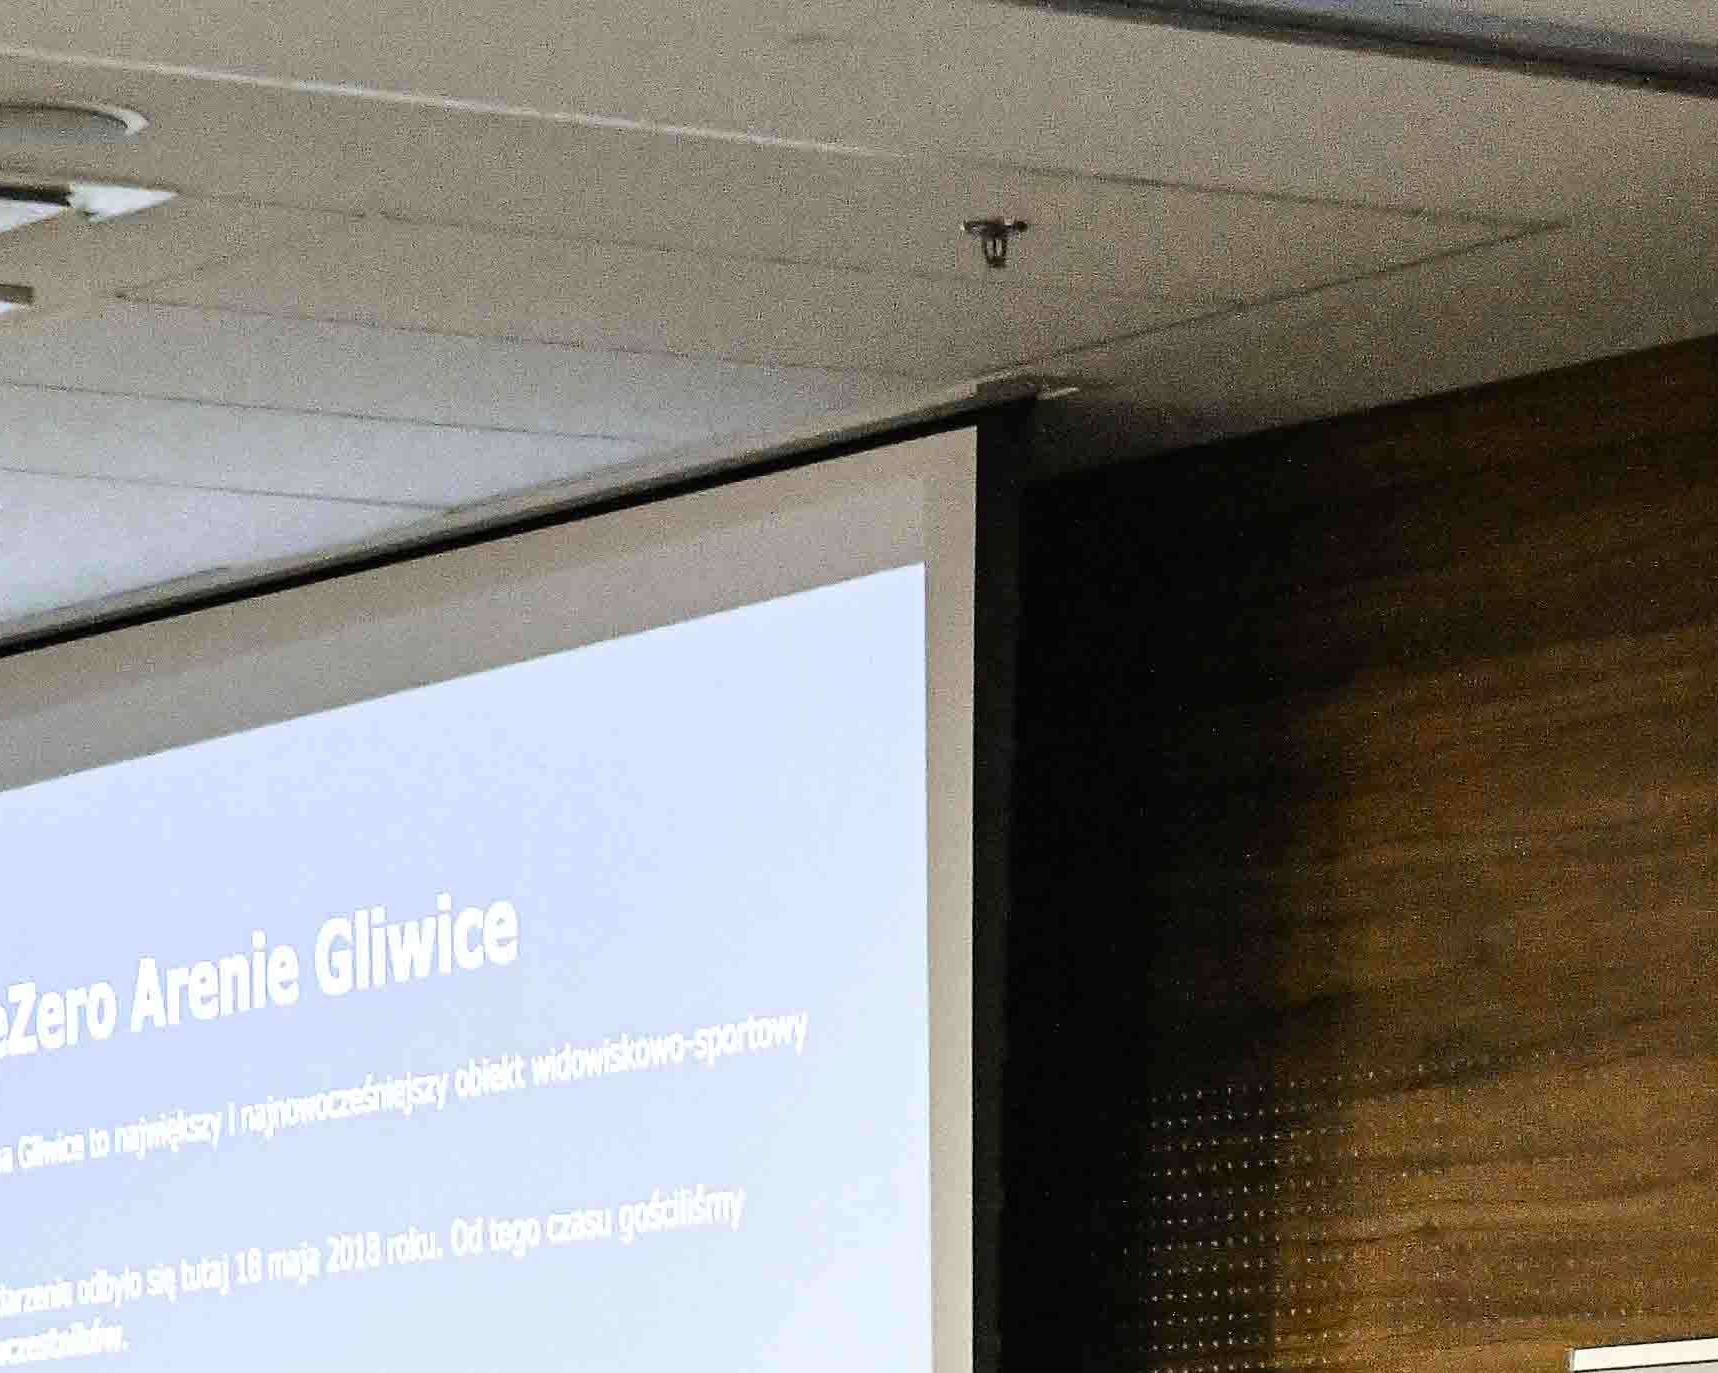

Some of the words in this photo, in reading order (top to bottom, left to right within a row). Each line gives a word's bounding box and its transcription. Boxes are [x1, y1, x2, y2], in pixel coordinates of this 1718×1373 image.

[130, 929, 300, 1031] Arenie
[316, 891, 521, 996] Gliwice
[18, 1129, 84, 1169] Gliwice
[90, 1127, 110, 1159] to
[115, 1109, 222, 1160] największy
[240, 1071, 451, 1143] najnowocześniejszy
[455, 1053, 527, 1098] obiekt
[531, 1009, 810, 1087] widowiskowo-sportowy
[181, 1252, 231, 1297] tutaj
[235, 1247, 262, 1285] 18
[267, 1240, 322, 1287] maja
[326, 1230, 381, 1273] 2018
[386, 1225, 443, 1265] roku.
[451, 1216, 483, 1257] Od
[488, 1217, 541, 1261] tego
[547, 1209, 612, 1244] czasu
[618, 1184, 746, 1246] gościliśmy
